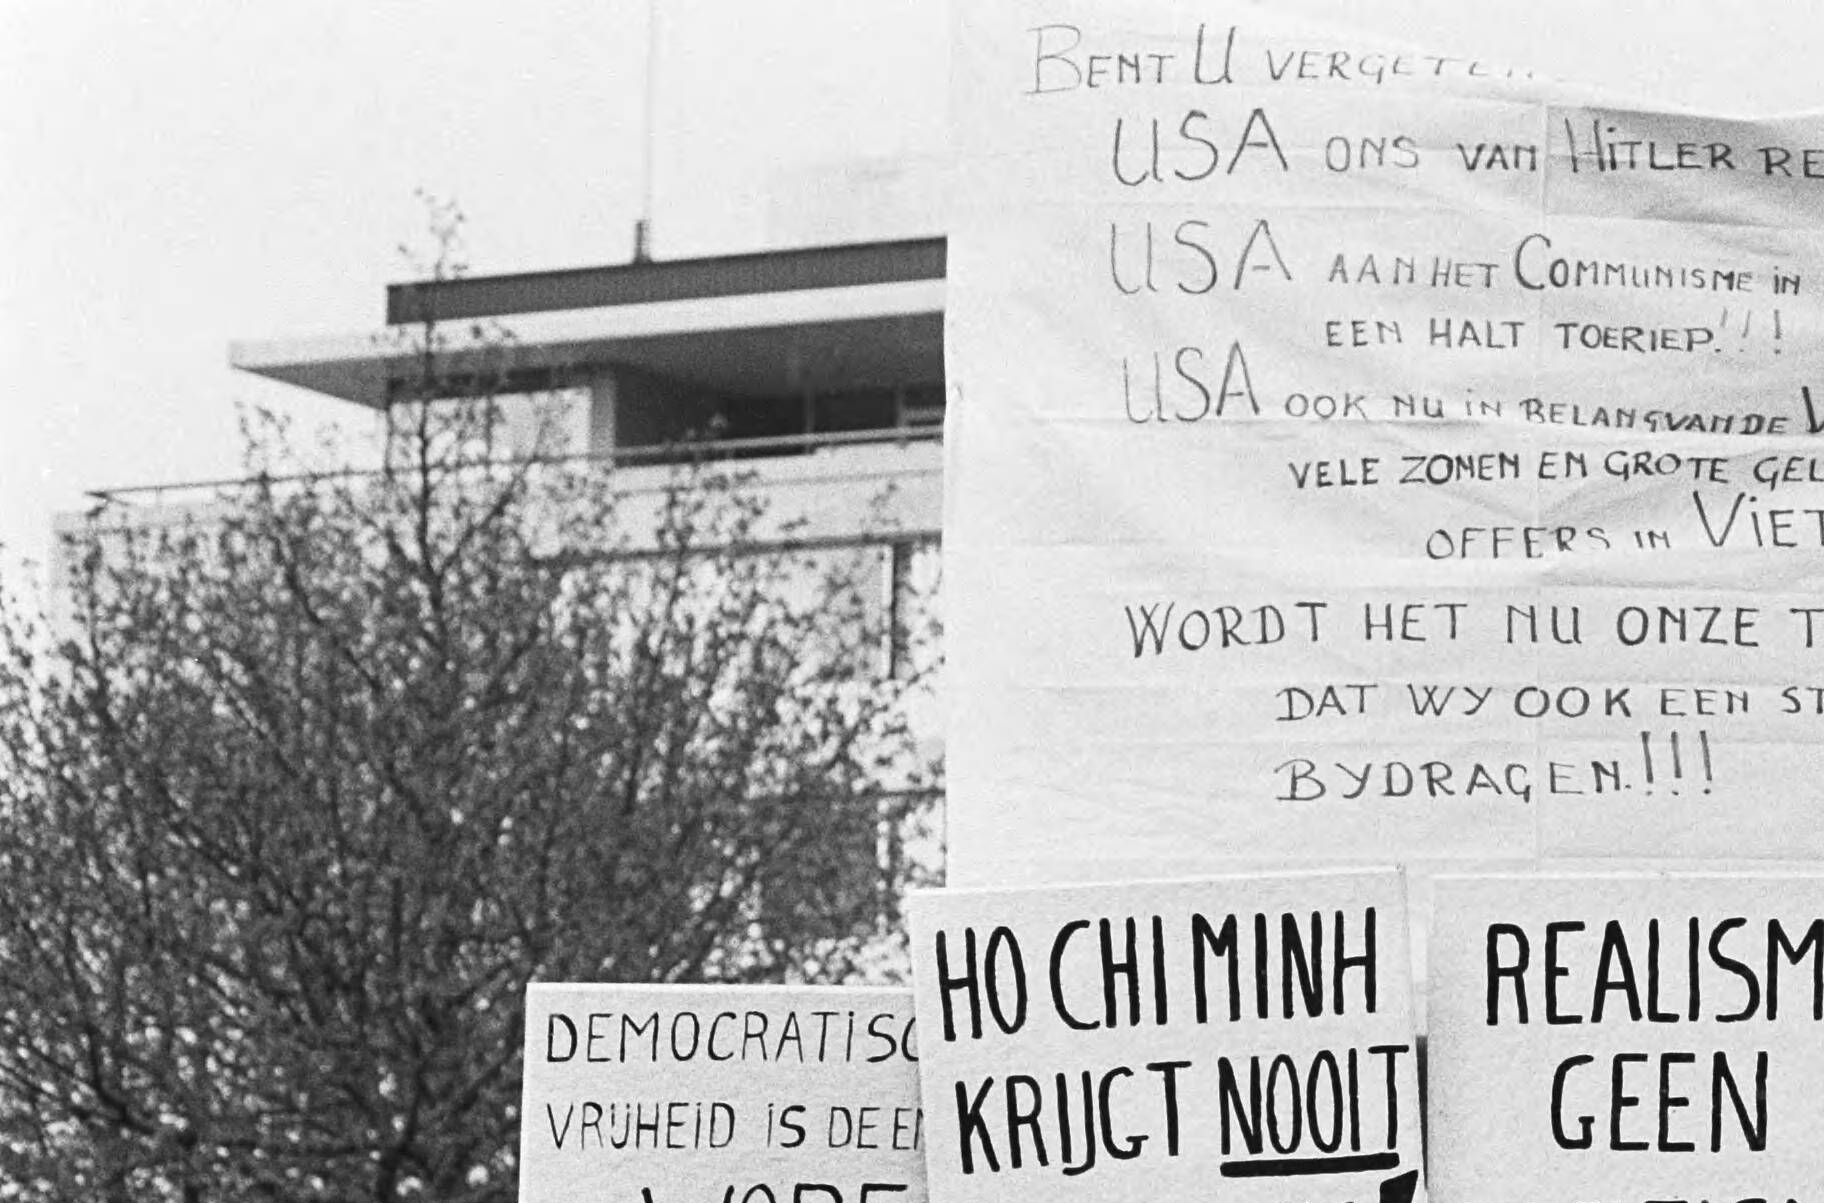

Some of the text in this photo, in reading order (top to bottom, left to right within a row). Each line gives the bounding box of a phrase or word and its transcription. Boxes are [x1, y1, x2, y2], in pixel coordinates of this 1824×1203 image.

[1194, 23, 1237, 85] U
[1112, 107, 1289, 187] USA
[1325, 135, 1422, 174] ONS
[1452, 138, 1540, 176] VAN
[1110, 219, 1293, 295] USA
[1328, 253, 1415, 286] AAN
[1430, 257, 1499, 289] HET
[1514, 233, 1753, 292] COMMUNISME
[1325, 320, 1402, 347] EEN
[1429, 317, 1525, 349] HALT
[1122, 339, 1260, 426] USA
[1284, 392, 1374, 425] OOK
[1391, 394, 1444, 419] NU
[1288, 457, 1380, 490] VELE
[1399, 452, 1520, 486] ZONEN
[1538, 451, 1588, 480] EN
[1603, 450, 1730, 484] GROTE
[1426, 525, 1611, 560] OFFERS
[1124, 601, 1328, 659] WORDT
[1364, 603, 1468, 642] HET
[1506, 605, 1582, 645] NU
[1616, 606, 1760, 647] ONZE
[1275, 683, 1379, 722] DAT
[1406, 683, 1494, 717] WY
[1514, 686, 1632, 718] OOK
[1660, 688, 1749, 717] EEN
[936, 906, 1377, 1042] HO CHI MINH
[955, 1042, 1410, 1176] KRIJGT NOOIT
[1551, 1051, 1768, 1153] GEEN
